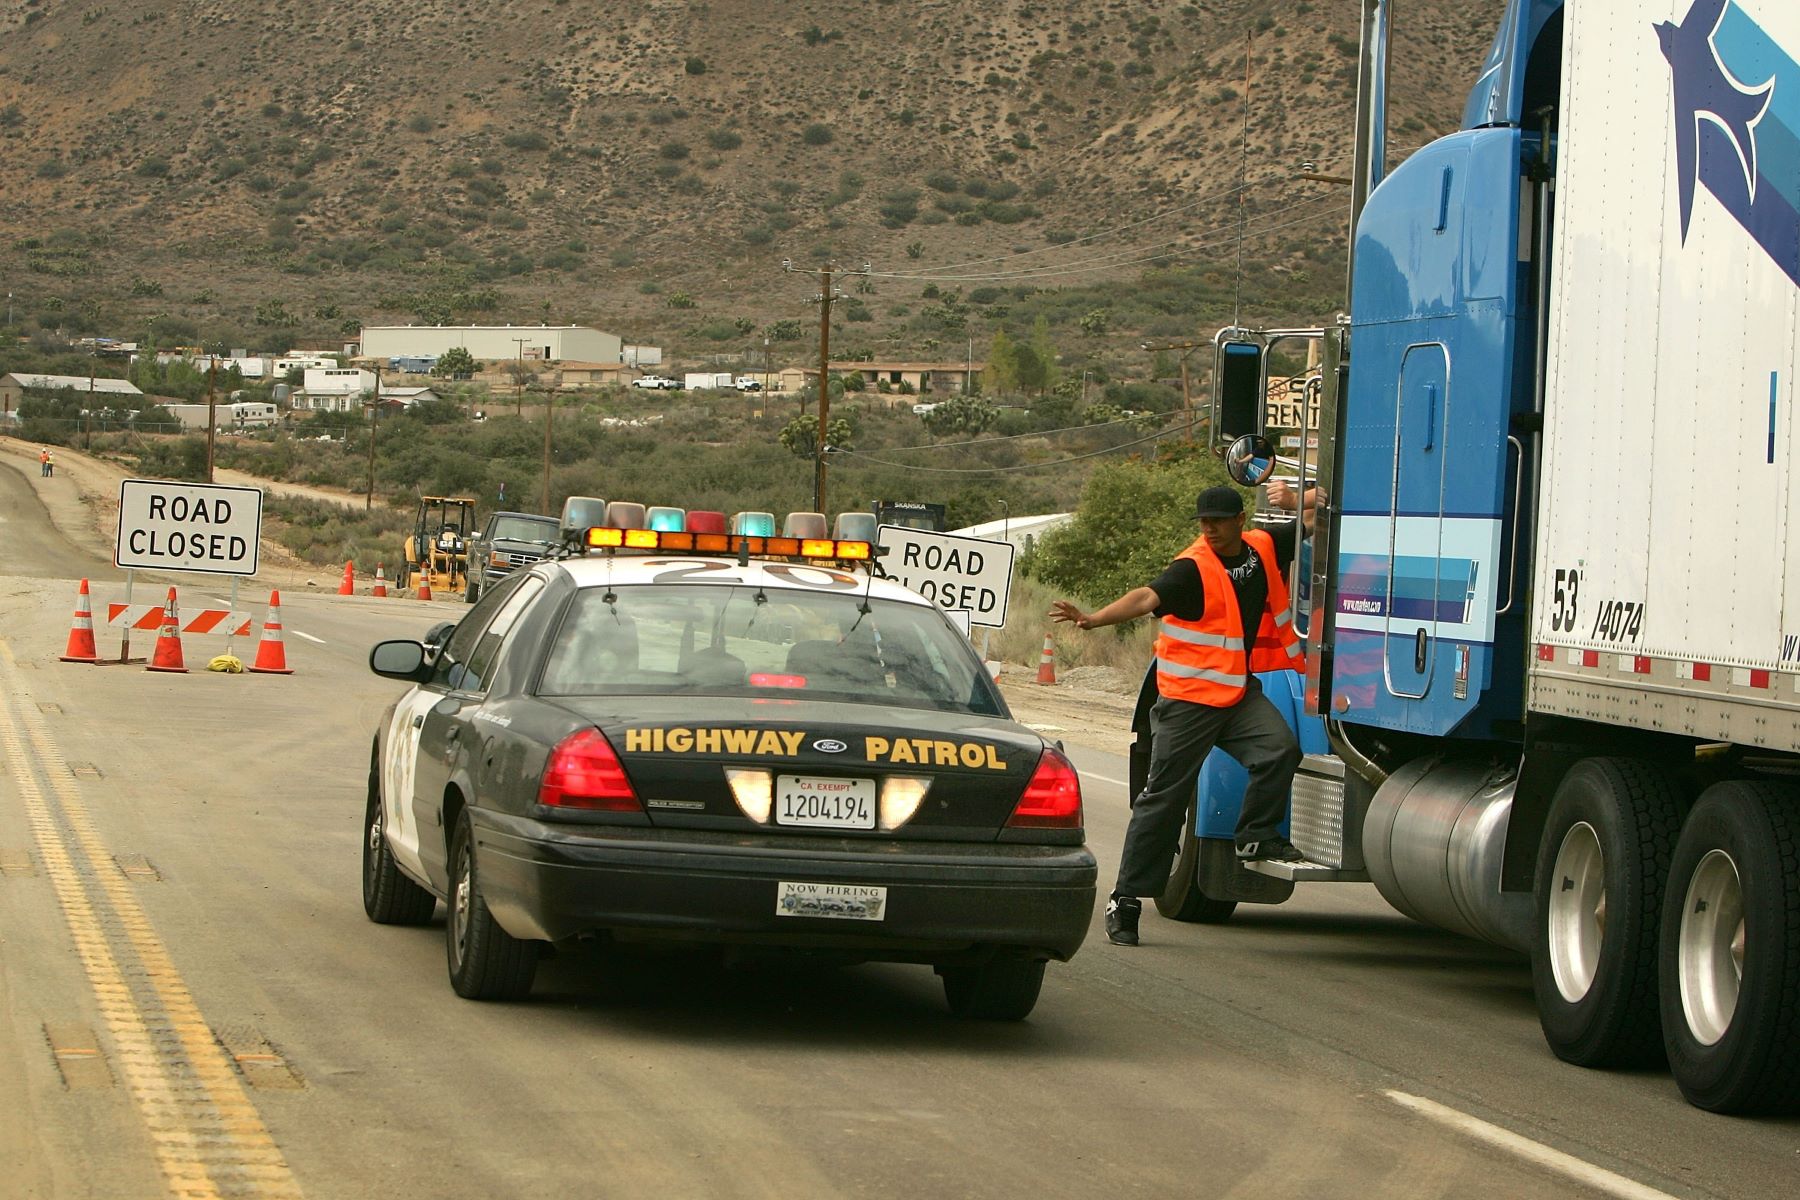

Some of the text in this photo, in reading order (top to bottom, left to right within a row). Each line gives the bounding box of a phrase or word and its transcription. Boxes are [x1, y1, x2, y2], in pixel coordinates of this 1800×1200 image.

[149, 495, 232, 524] ROAD
[894, 502, 926, 510] SKANSKA
[129, 529, 247, 561] CLOSED
[903, 542, 985, 576] ROAD
[626, 728, 1007, 770] HIGHWAY PATROL
[800, 782, 852, 791] CA EXEMPT
[784, 794, 868, 820] 1204194
[786, 884, 879, 897] NOW HIRING
